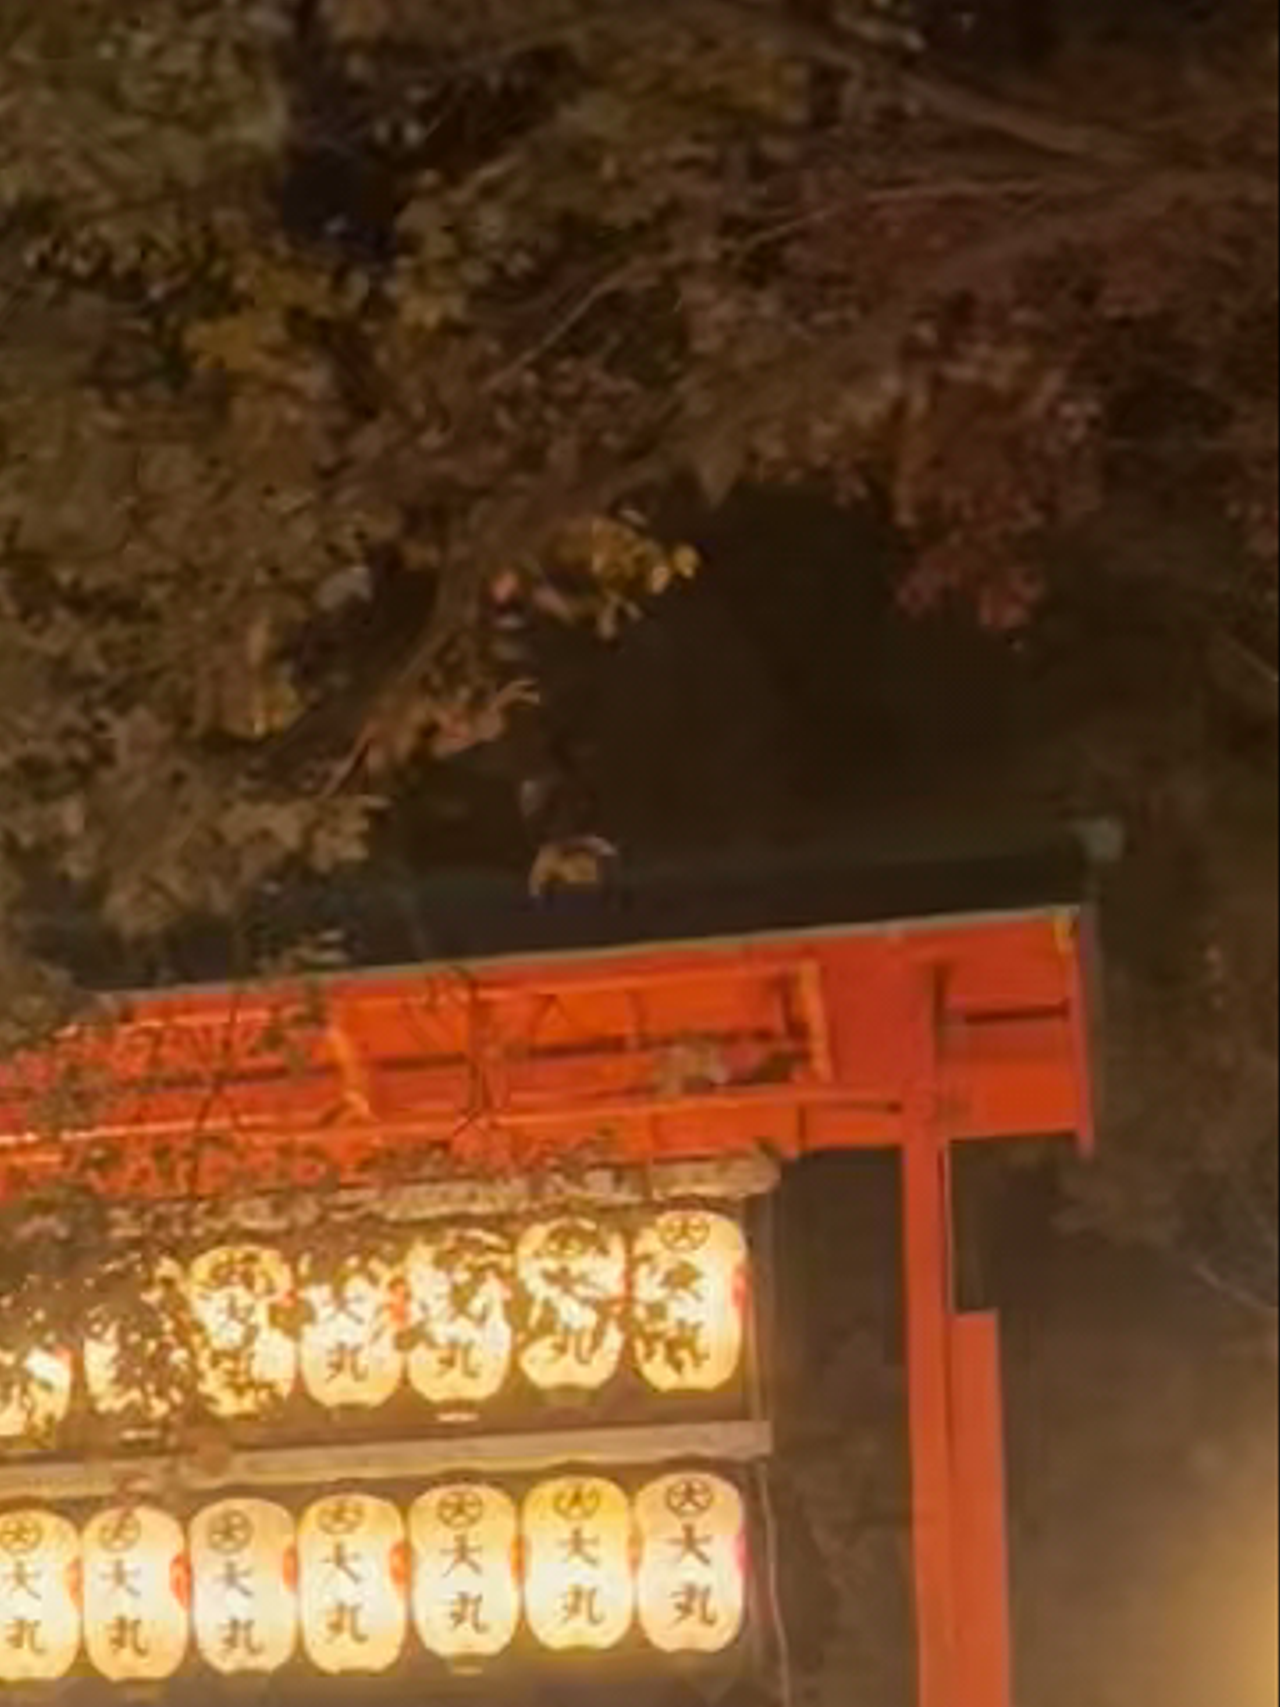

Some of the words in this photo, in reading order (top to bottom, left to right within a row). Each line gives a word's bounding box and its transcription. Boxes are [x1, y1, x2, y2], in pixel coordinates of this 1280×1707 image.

[3, 1560, 48, 1658] 大丸
[100, 1558, 150, 1658] 大丸
[213, 1560, 265, 1658] 大丸
[320, 1541, 370, 1645] 大丸
[438, 1533, 491, 1637] 大丸
[555, 1526, 607, 1629] 大丸
[664, 1523, 721, 1630] 大丸
